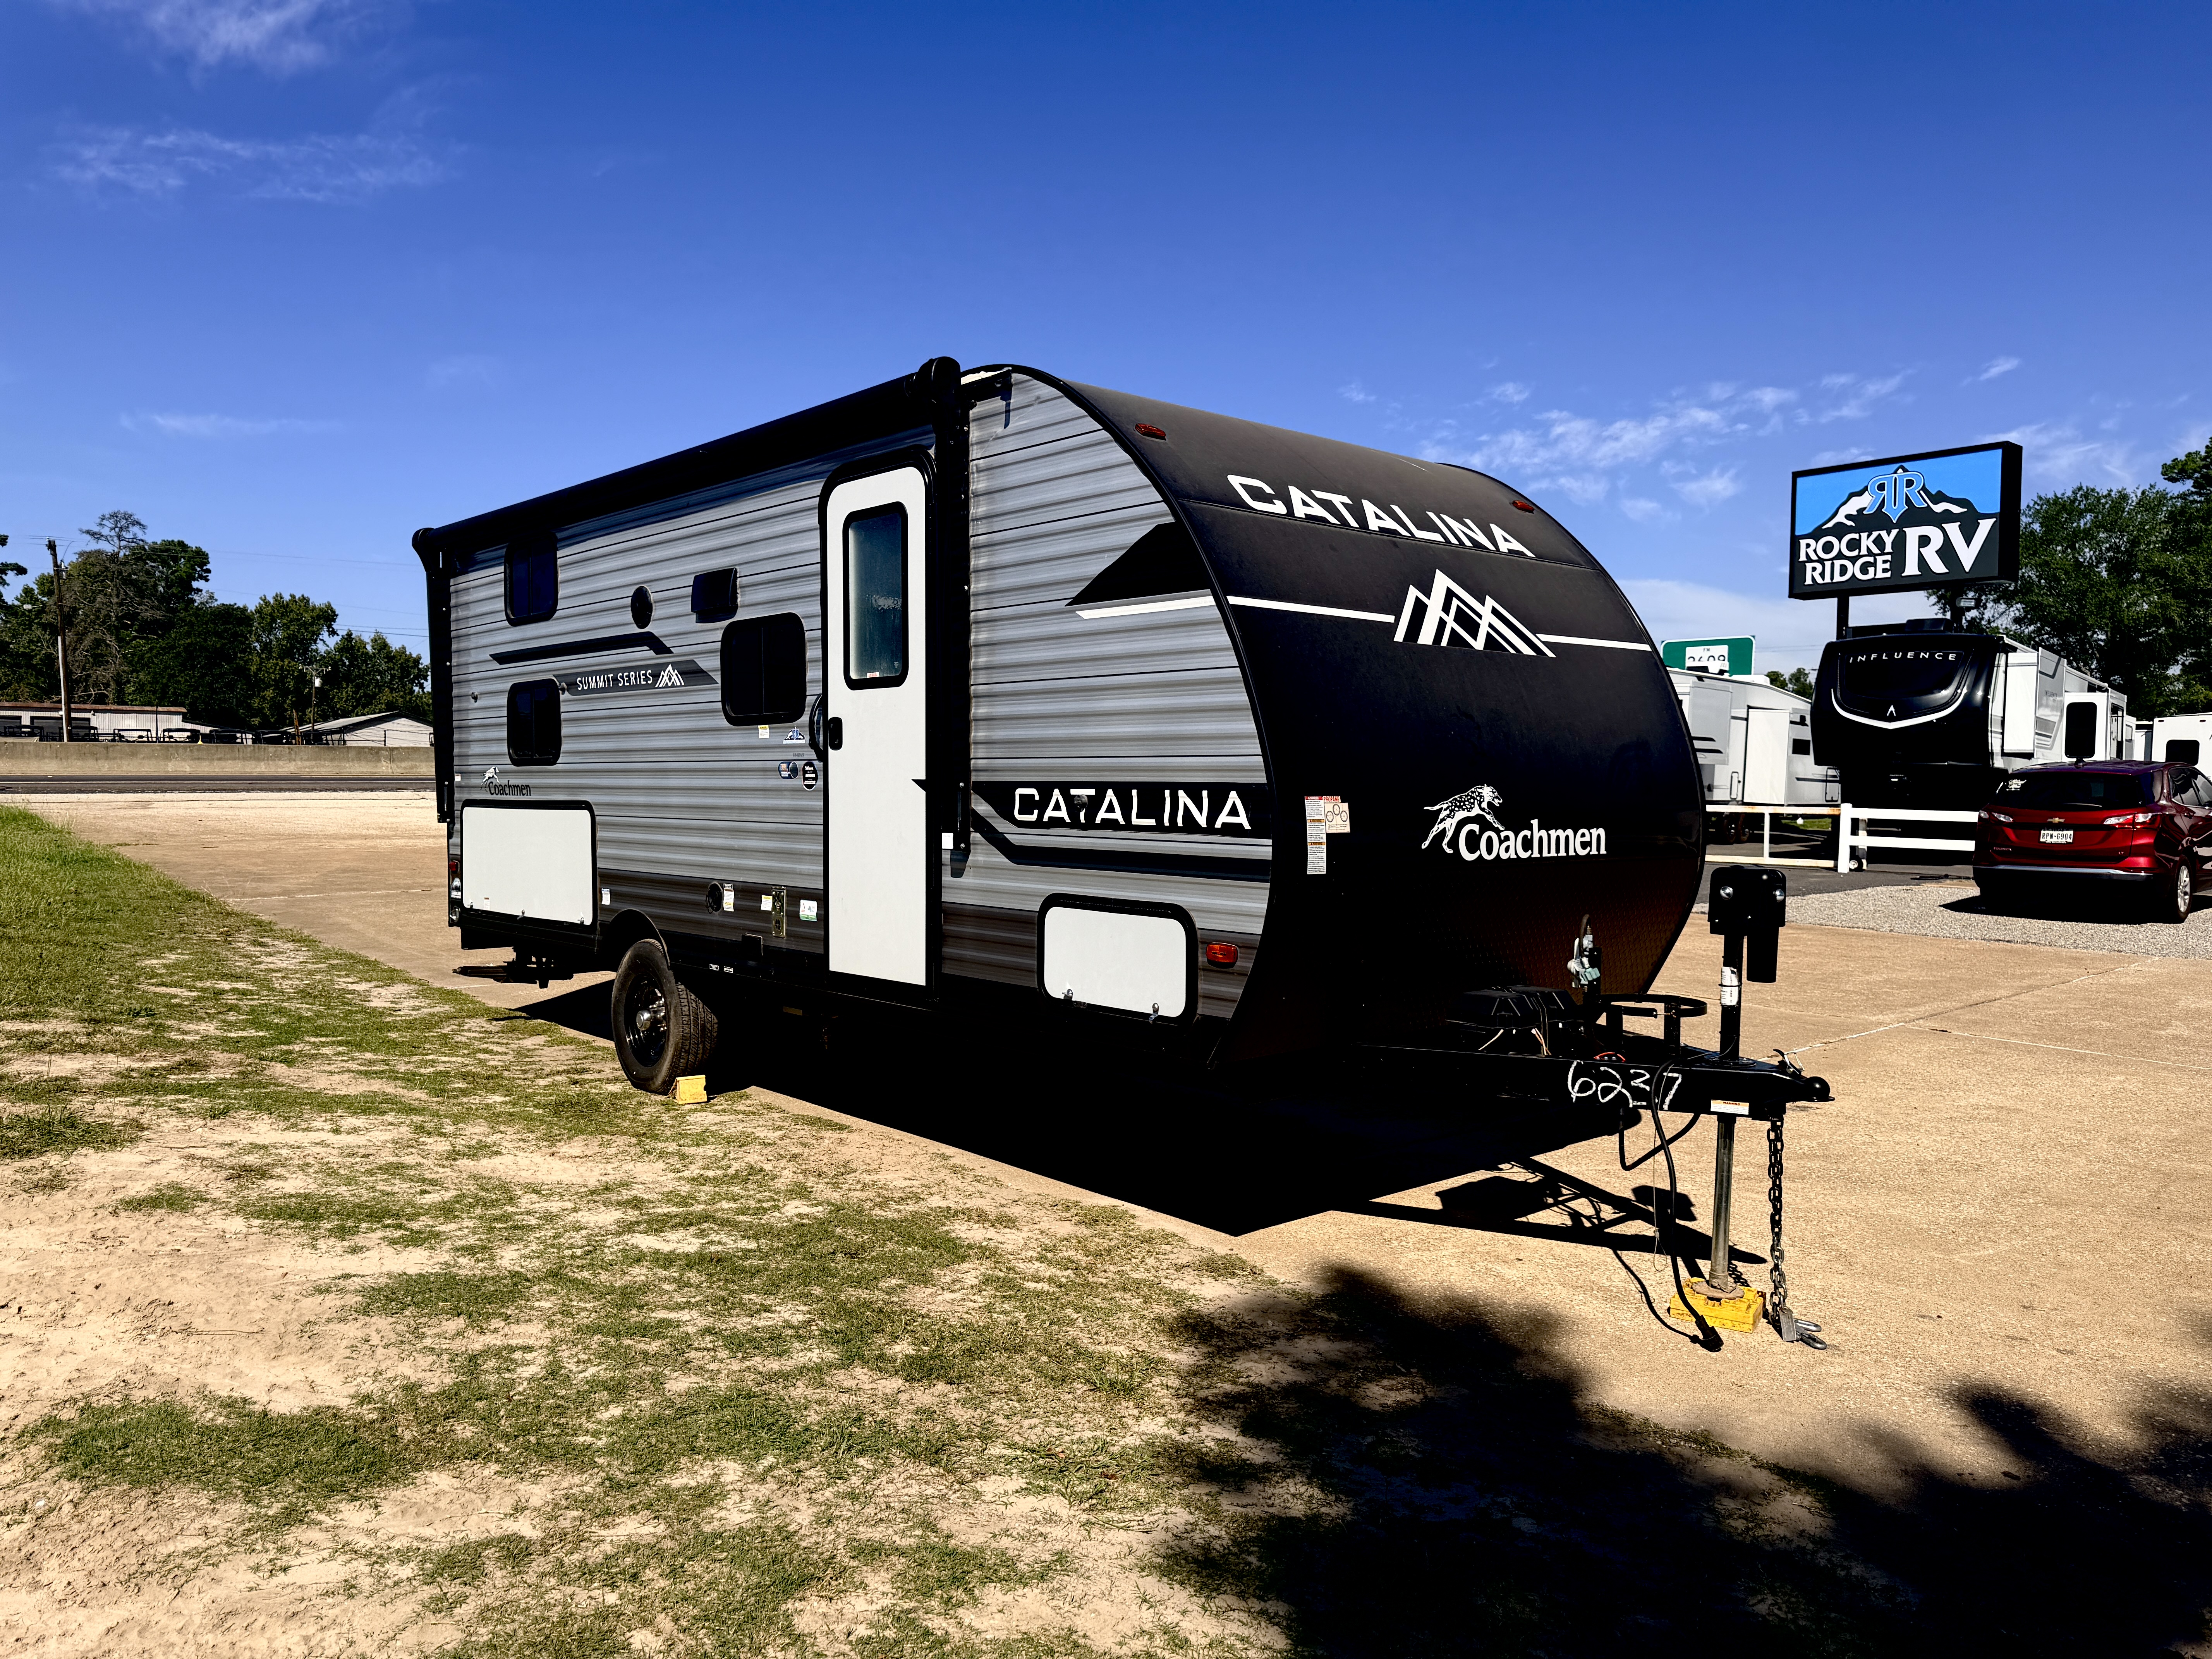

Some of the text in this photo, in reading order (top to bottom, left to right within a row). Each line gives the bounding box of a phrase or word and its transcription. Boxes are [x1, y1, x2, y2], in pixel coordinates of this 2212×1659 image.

[1227, 474, 1535, 557] CATALINA
[1798, 529, 1899, 562] ROCKY
[1901, 518, 1997, 577] RV
[1804, 555, 1891, 585] RIDGE
[1850, 652, 1956, 663] INFLUENCE
[577, 670, 653, 690] SUMMIT SERIES
[488, 780, 531, 796] Coachmen
[1013, 788, 1252, 830] CATALINA
[1458, 819, 1607, 861] Coachmen
